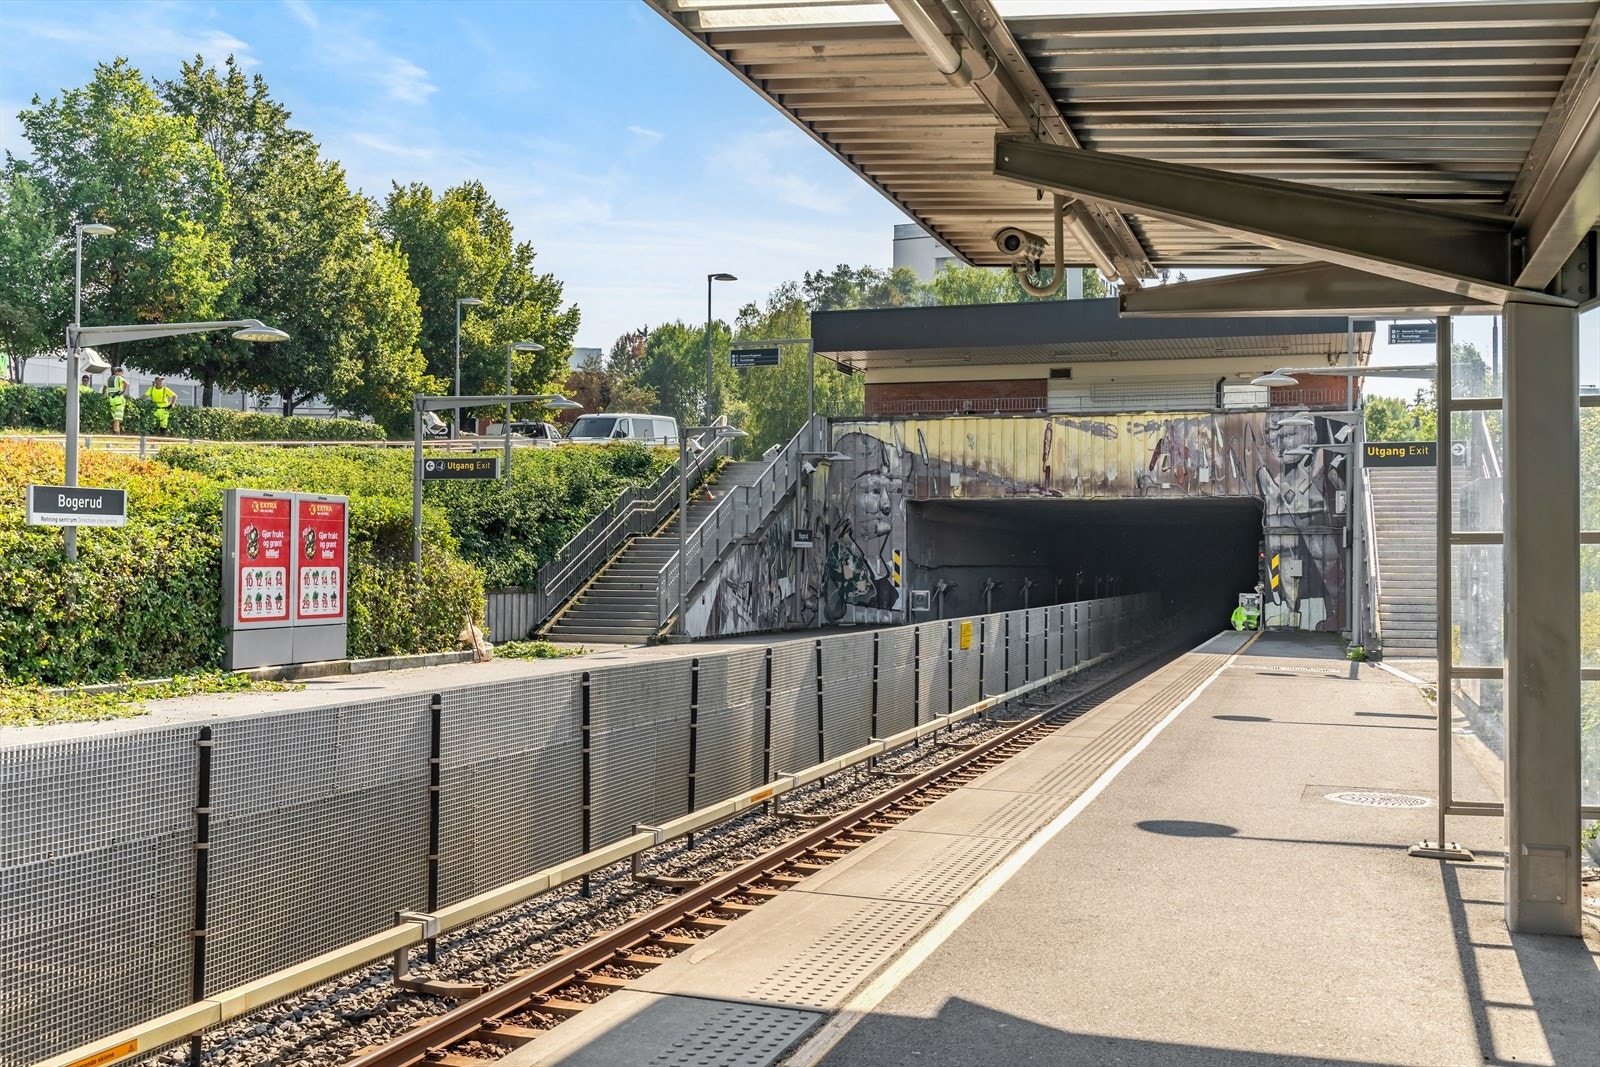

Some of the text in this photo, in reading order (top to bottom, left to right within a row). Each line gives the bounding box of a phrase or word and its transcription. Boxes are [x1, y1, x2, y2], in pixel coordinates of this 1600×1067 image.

[1367, 445, 1429, 458] Utgang Exit
[447, 461, 491, 471] Utgang Exit
[58, 493, 103, 511] Bogerud
[262, 530, 284, 539] Gjør frukt
[328, 532, 338, 540] frukt
[269, 540, 282, 549] grønt
[246, 577, 282, 587] 10 12 14 14
[304, 576, 337, 586] 10 12 14 14
[244, 600, 282, 612] 29 19 19 12
[302, 598, 337, 609] 29 19 19 12
